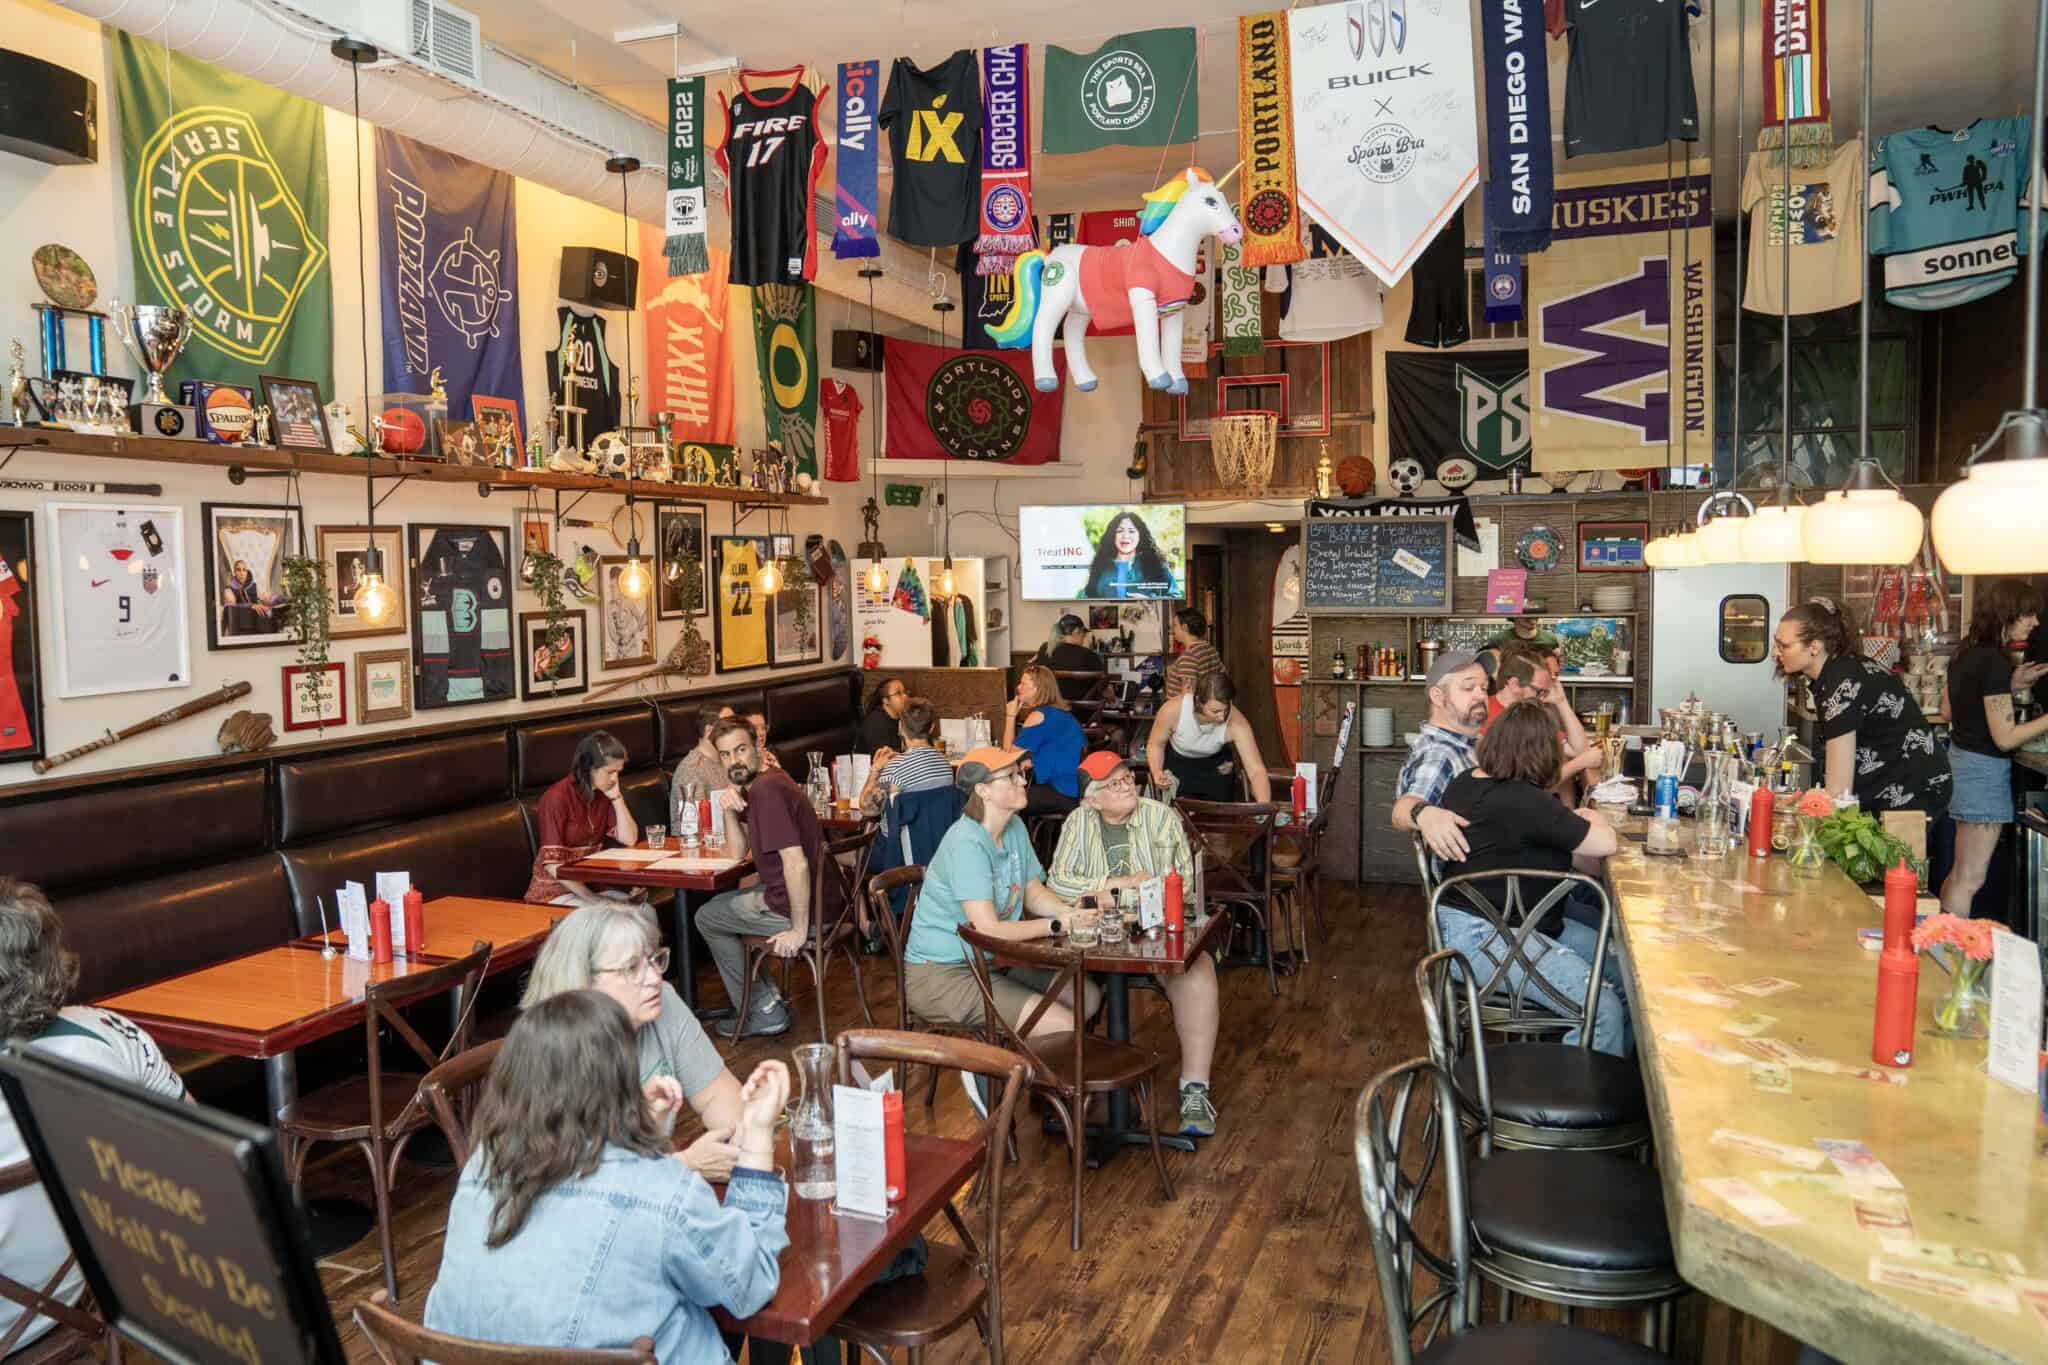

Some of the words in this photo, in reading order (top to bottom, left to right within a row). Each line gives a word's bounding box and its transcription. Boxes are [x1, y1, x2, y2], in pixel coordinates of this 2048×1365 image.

[1089, 67, 1103, 84] THE
[1102, 56, 1133, 70] SPORTS
[1133, 62, 1146, 79] BRA
[1328, 62, 1433, 89] BUICK
[1089, 102, 1121, 125] PORTLAND
[1123, 96, 1150, 124] OREGON
[1251, 19, 1280, 172] PORTLAND
[1505, 51, 1528, 144] DIEGO
[675, 91, 694, 148] 2022
[733, 115, 807, 140] FIRE
[905, 109, 965, 164] IX
[991, 91, 1017, 167] SOCCER
[746, 136, 786, 168] 17
[1347, 141, 1391, 164] Sports
[1396, 136, 1424, 154] Bra
[152, 126, 241, 229] SEATTLE
[1511, 153, 1531, 215] SAN
[842, 212, 868, 227] ally
[386, 167, 429, 375] PORTLAND
[1924, 239, 2017, 275] sonnet
[162, 249, 254, 343] STORM
[989, 272, 1010, 293] IN
[575, 339, 594, 374] 20
[1540, 257, 1671, 446] W
[1683, 260, 1705, 431] WASHINGTON
[935, 362, 1022, 400] PORTLAND
[938, 424, 1022, 458] THORNS
[1380, 503, 1461, 518] KNEW
[118, 596, 131, 623] 9
[731, 581, 752, 617] 22
[86, 1136, 207, 1225] Please
[79, 1188, 166, 1264] Wait
[159, 1230, 215, 1288] To
[217, 1256, 277, 1320] Be
